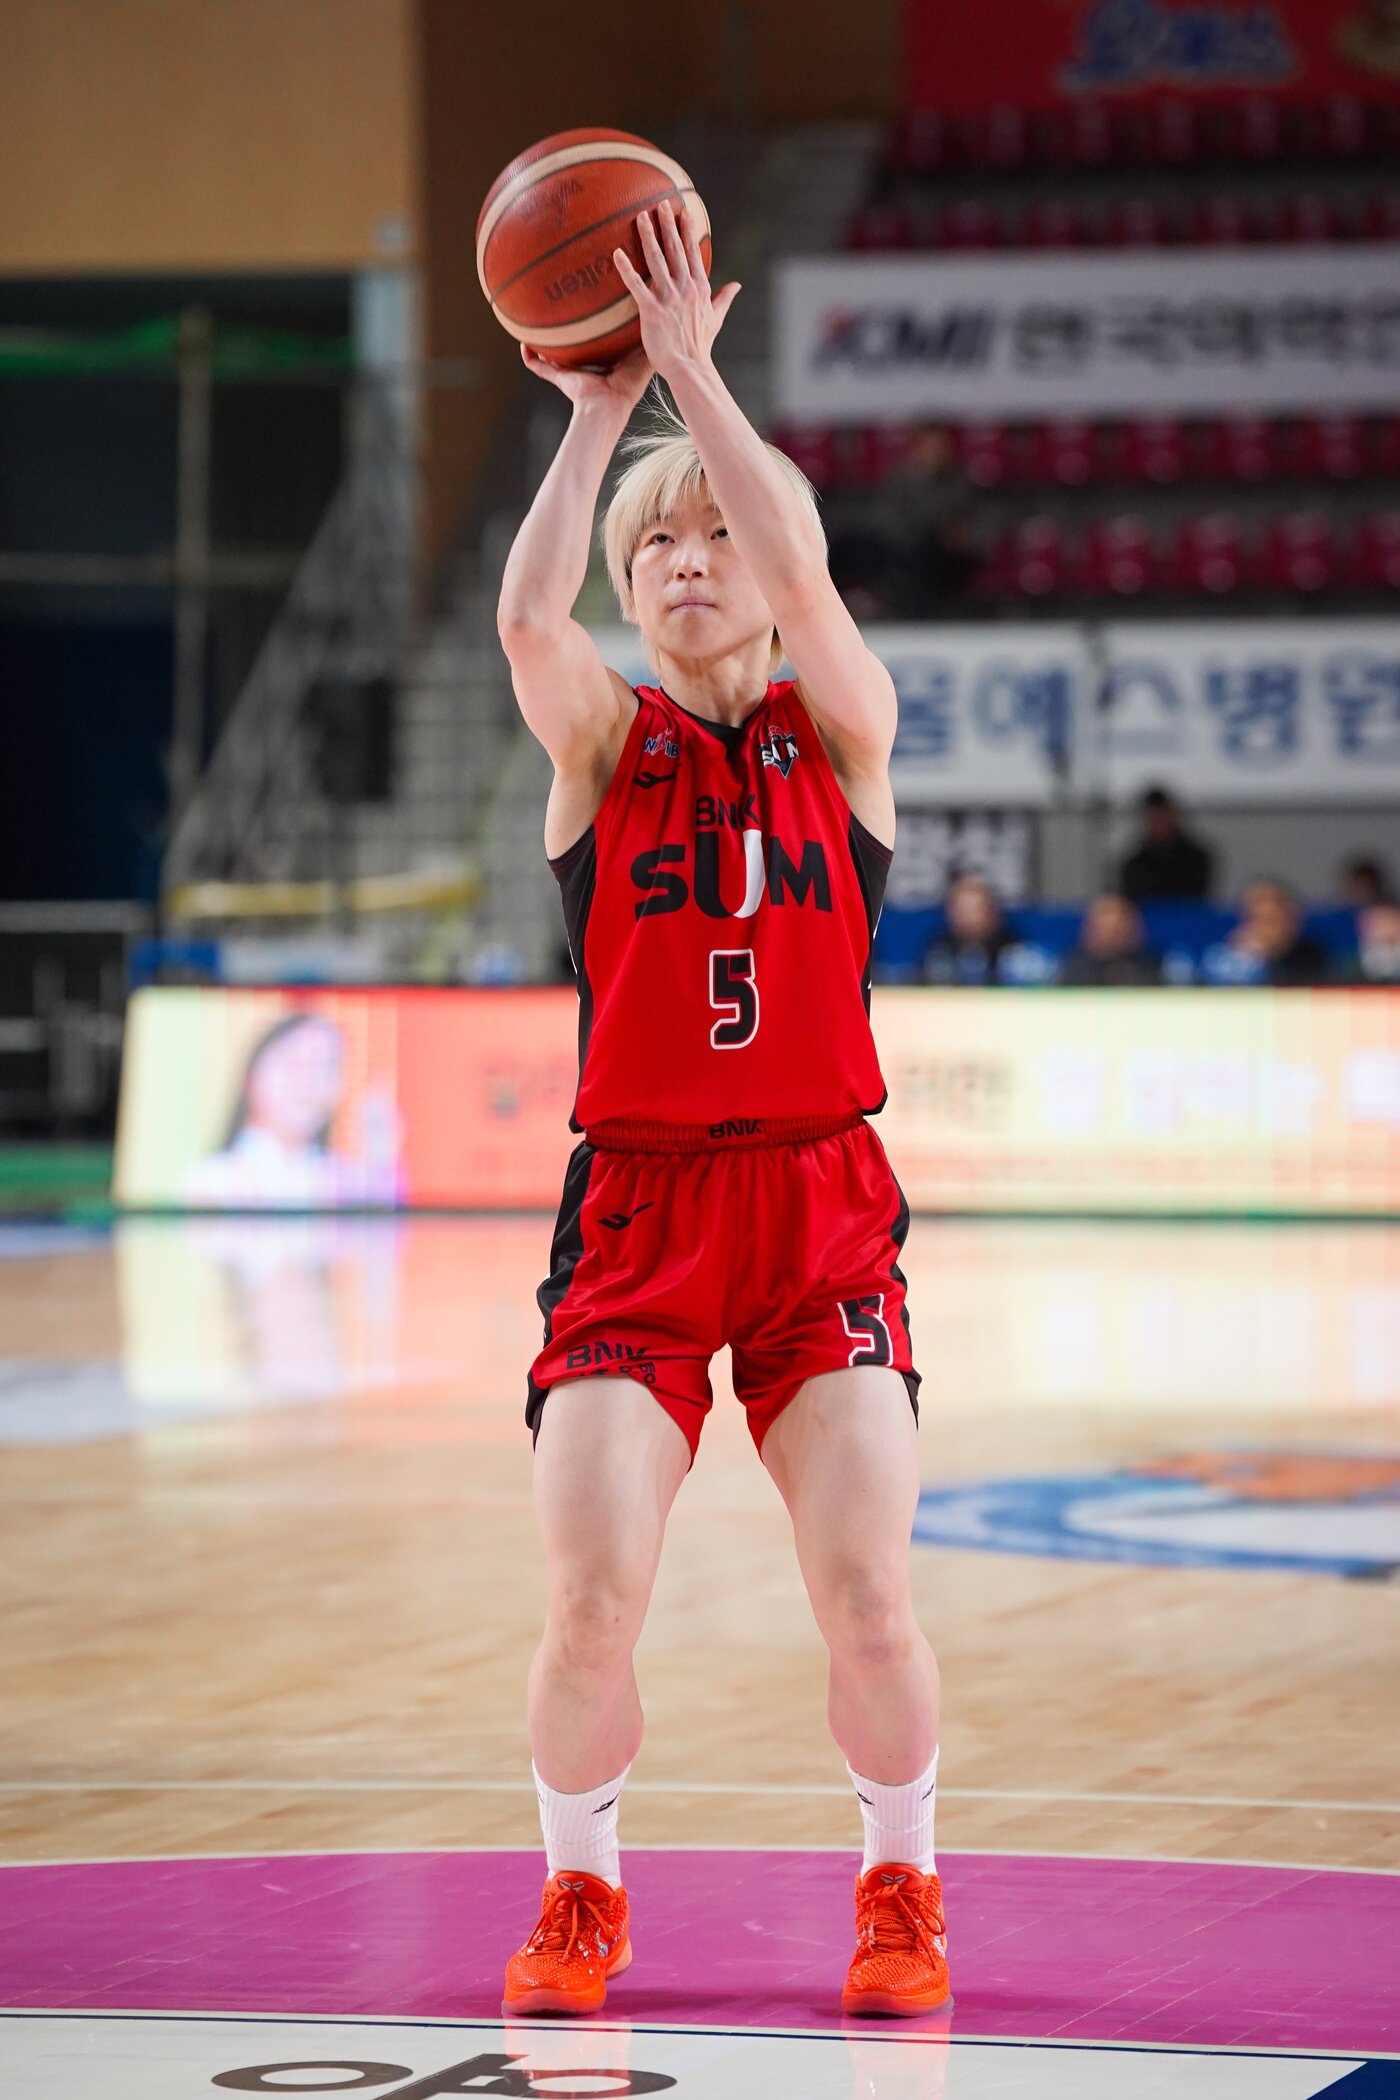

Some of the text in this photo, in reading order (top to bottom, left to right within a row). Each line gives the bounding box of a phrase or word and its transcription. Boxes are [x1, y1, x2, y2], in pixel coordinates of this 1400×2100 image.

[695, 793, 760, 830] BNK
[629, 828, 833, 922] SUM
[709, 949, 760, 1050] 5
[709, 1119, 762, 1139] BNK
[837, 1293, 894, 1367] 5
